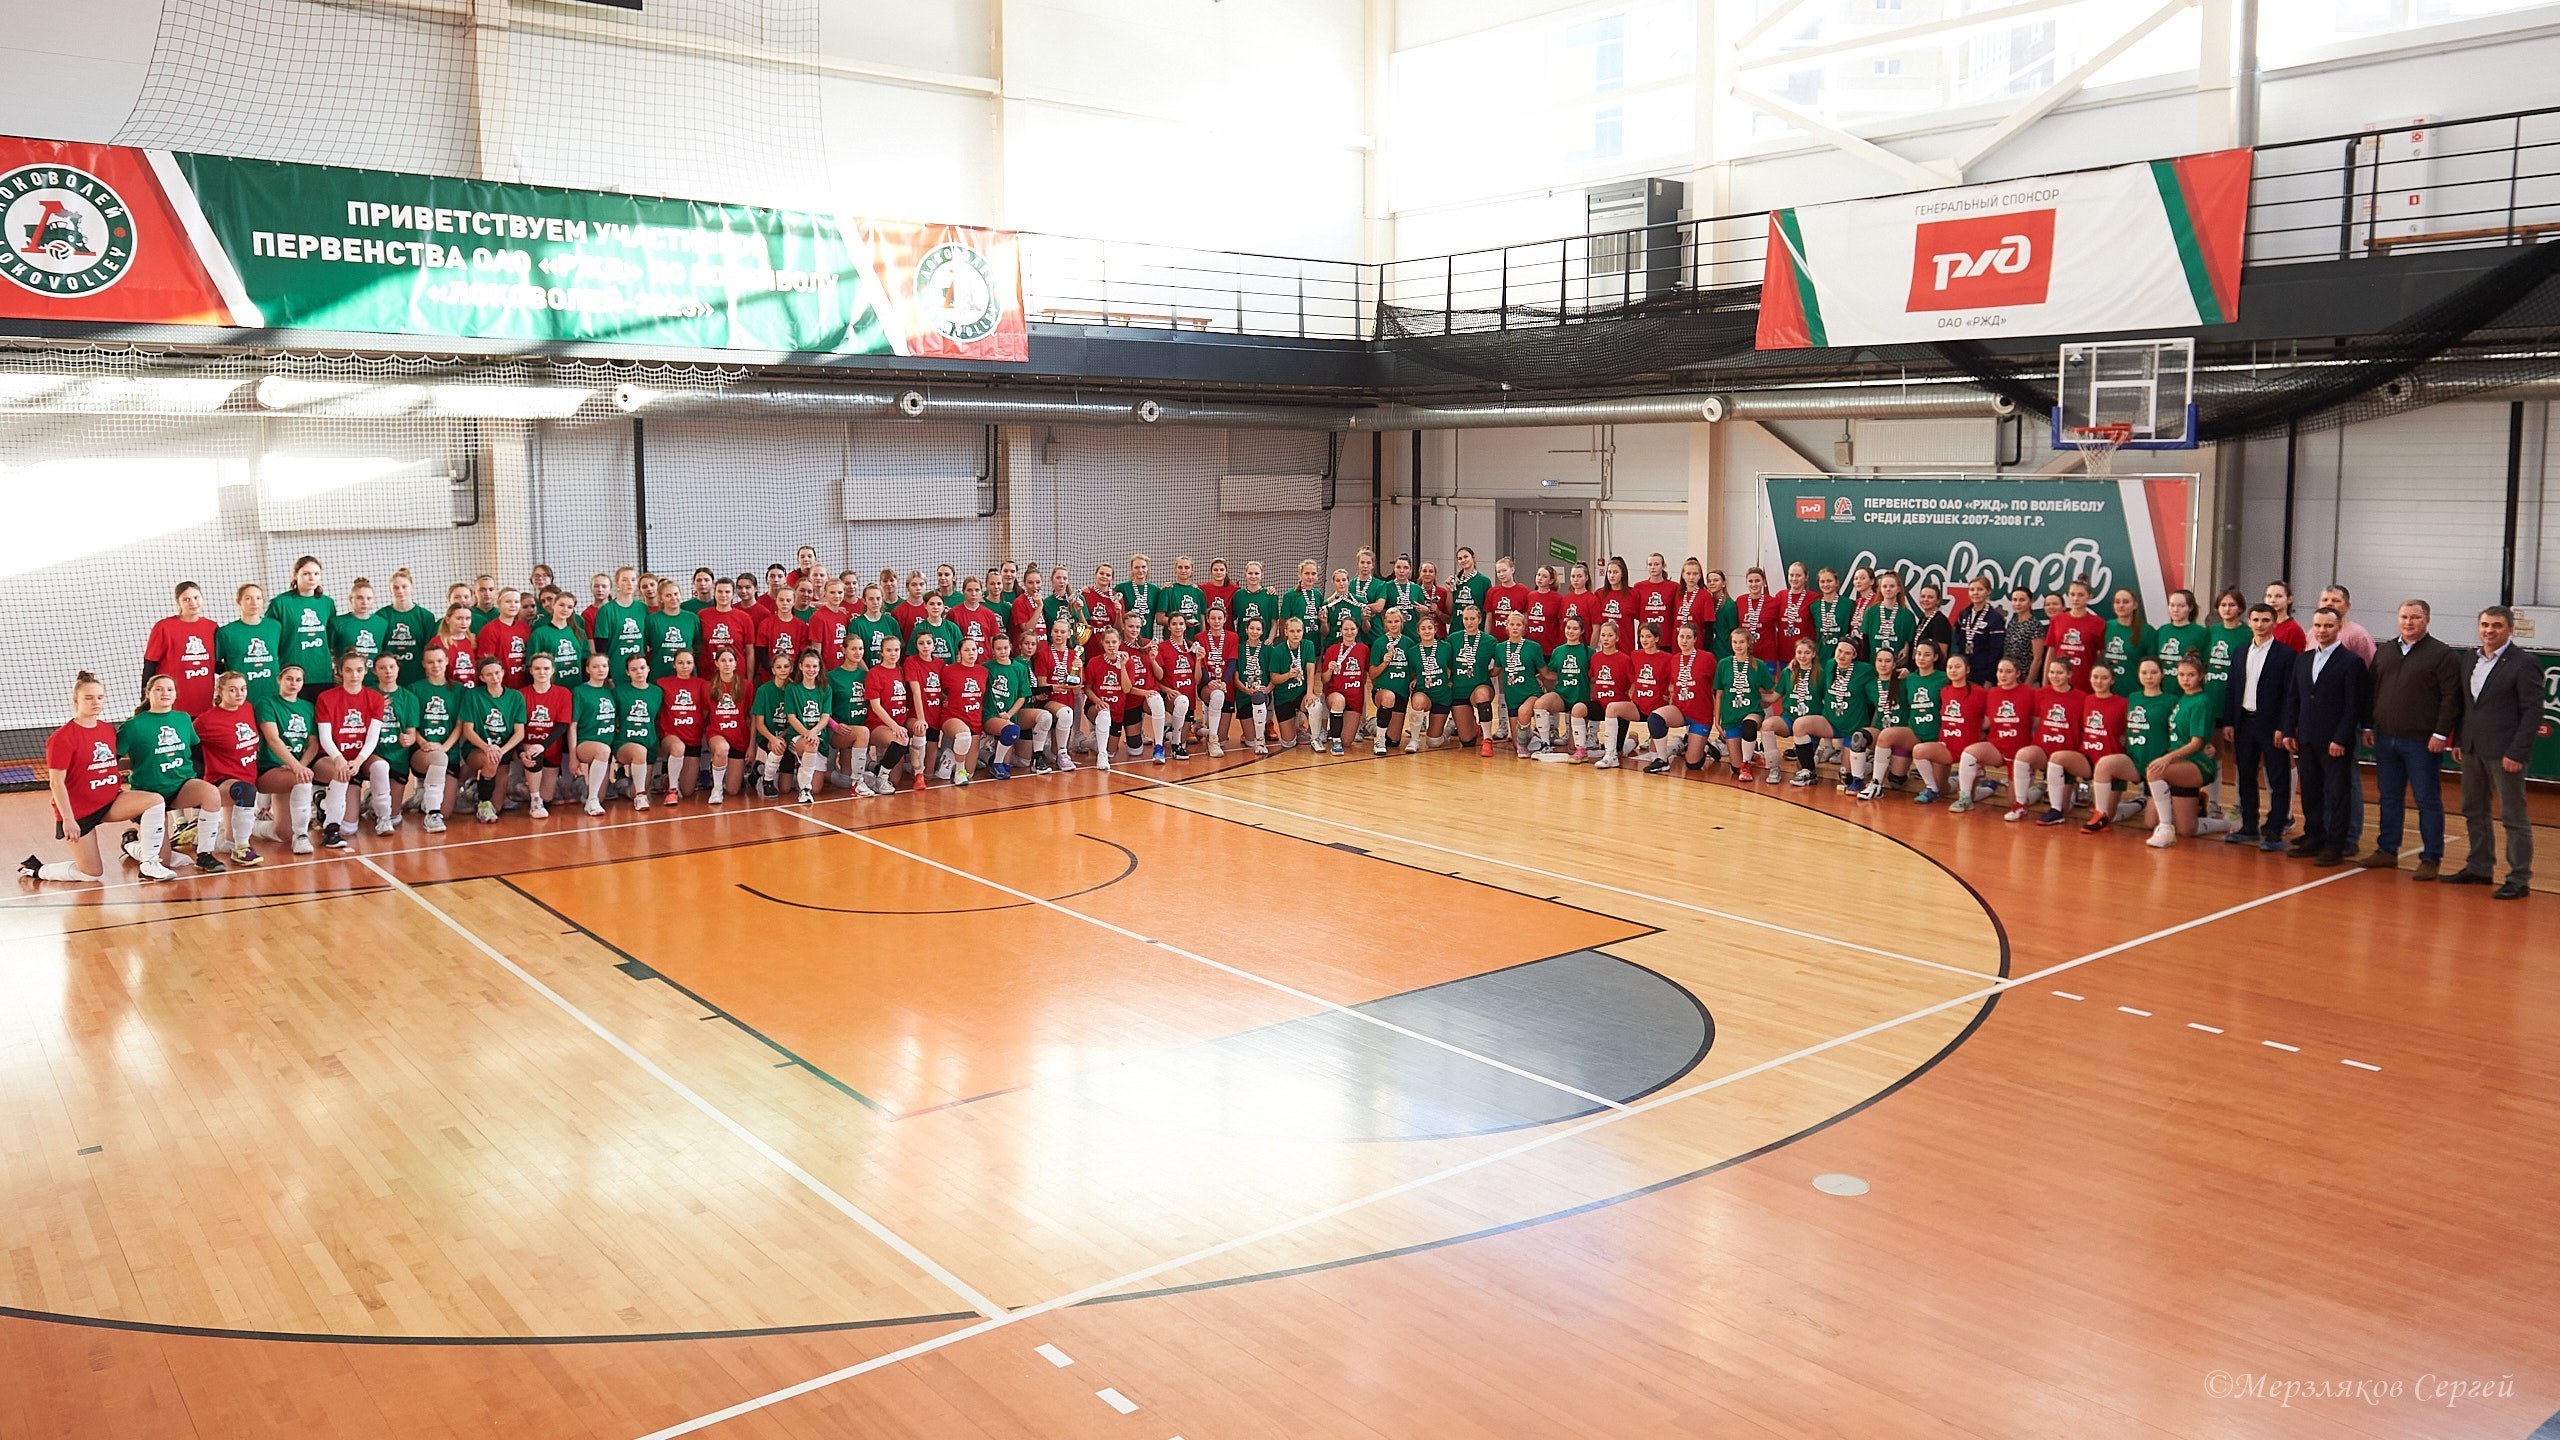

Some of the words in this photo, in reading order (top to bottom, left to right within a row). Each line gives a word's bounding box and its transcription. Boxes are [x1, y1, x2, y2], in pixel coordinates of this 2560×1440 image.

[1915, 195, 1998, 216] ГЕНЕРАЛЬНЫЙ
[2002, 189, 2059, 206] СПОНСОР
[347, 201, 588, 243] ПРИВЕТСТВУЕМ
[252, 231, 468, 271] ПЕРВЕНСТВА
[472, 248, 531, 274] ОАО
[1938, 318, 1962, 328] ОАО
[1966, 315, 2007, 327] «РЖД»
[1864, 498, 1937, 510] ПЕРВЕНСТВО
[1939, 499, 1962, 510] ОАО
[1964, 500, 2009, 512] «РЖД»
[2011, 500, 2028, 511] ПО
[2030, 499, 2105, 512] ВОЛЕЙБОЛУ
[1864, 513, 1901, 525] СРЕДИ
[1903, 514, 1960, 525] ДЕВУШЕК
[1961, 515, 2022, 526] 2007-2008
[2024, 516, 2045, 526] Г.Р.
